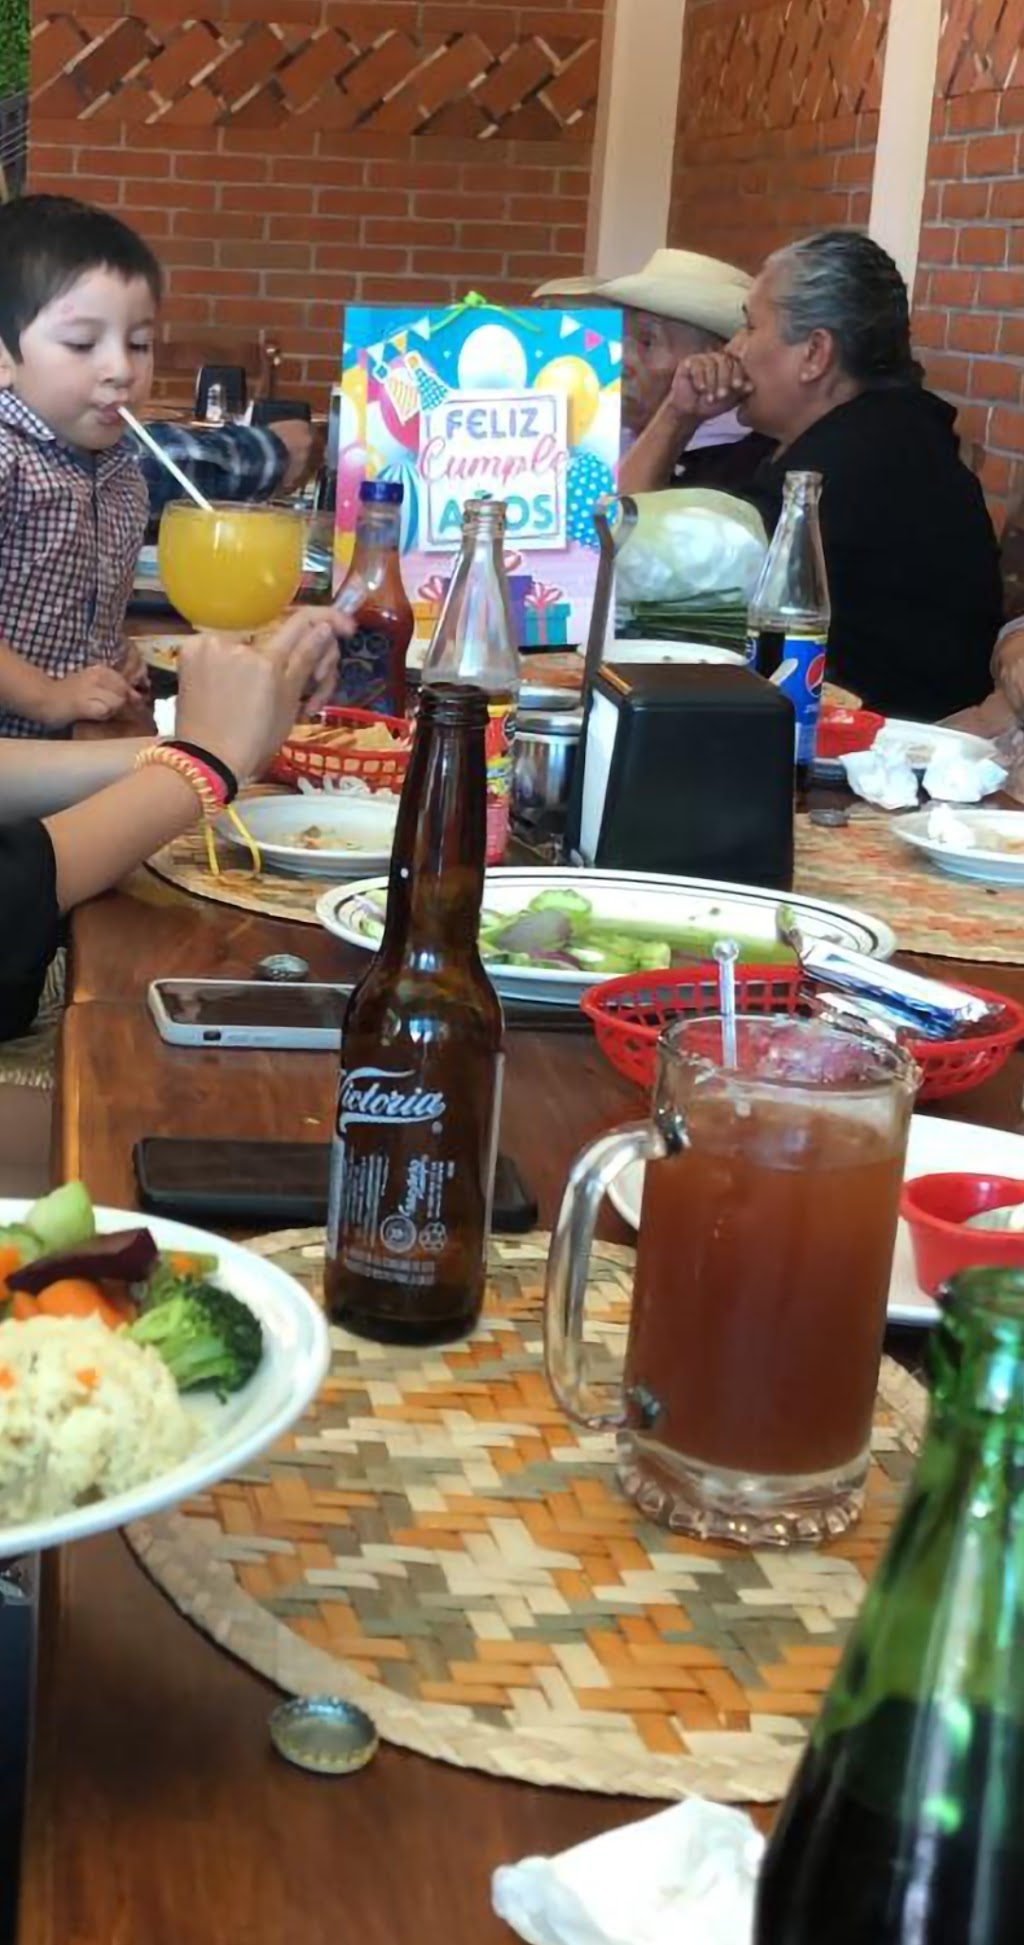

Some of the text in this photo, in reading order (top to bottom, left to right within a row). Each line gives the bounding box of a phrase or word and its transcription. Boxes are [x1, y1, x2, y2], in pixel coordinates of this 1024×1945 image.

[446, 407, 540, 440] FELIZ
[420, 433, 567, 485] Cumple
[438, 489, 554, 533] AOS
